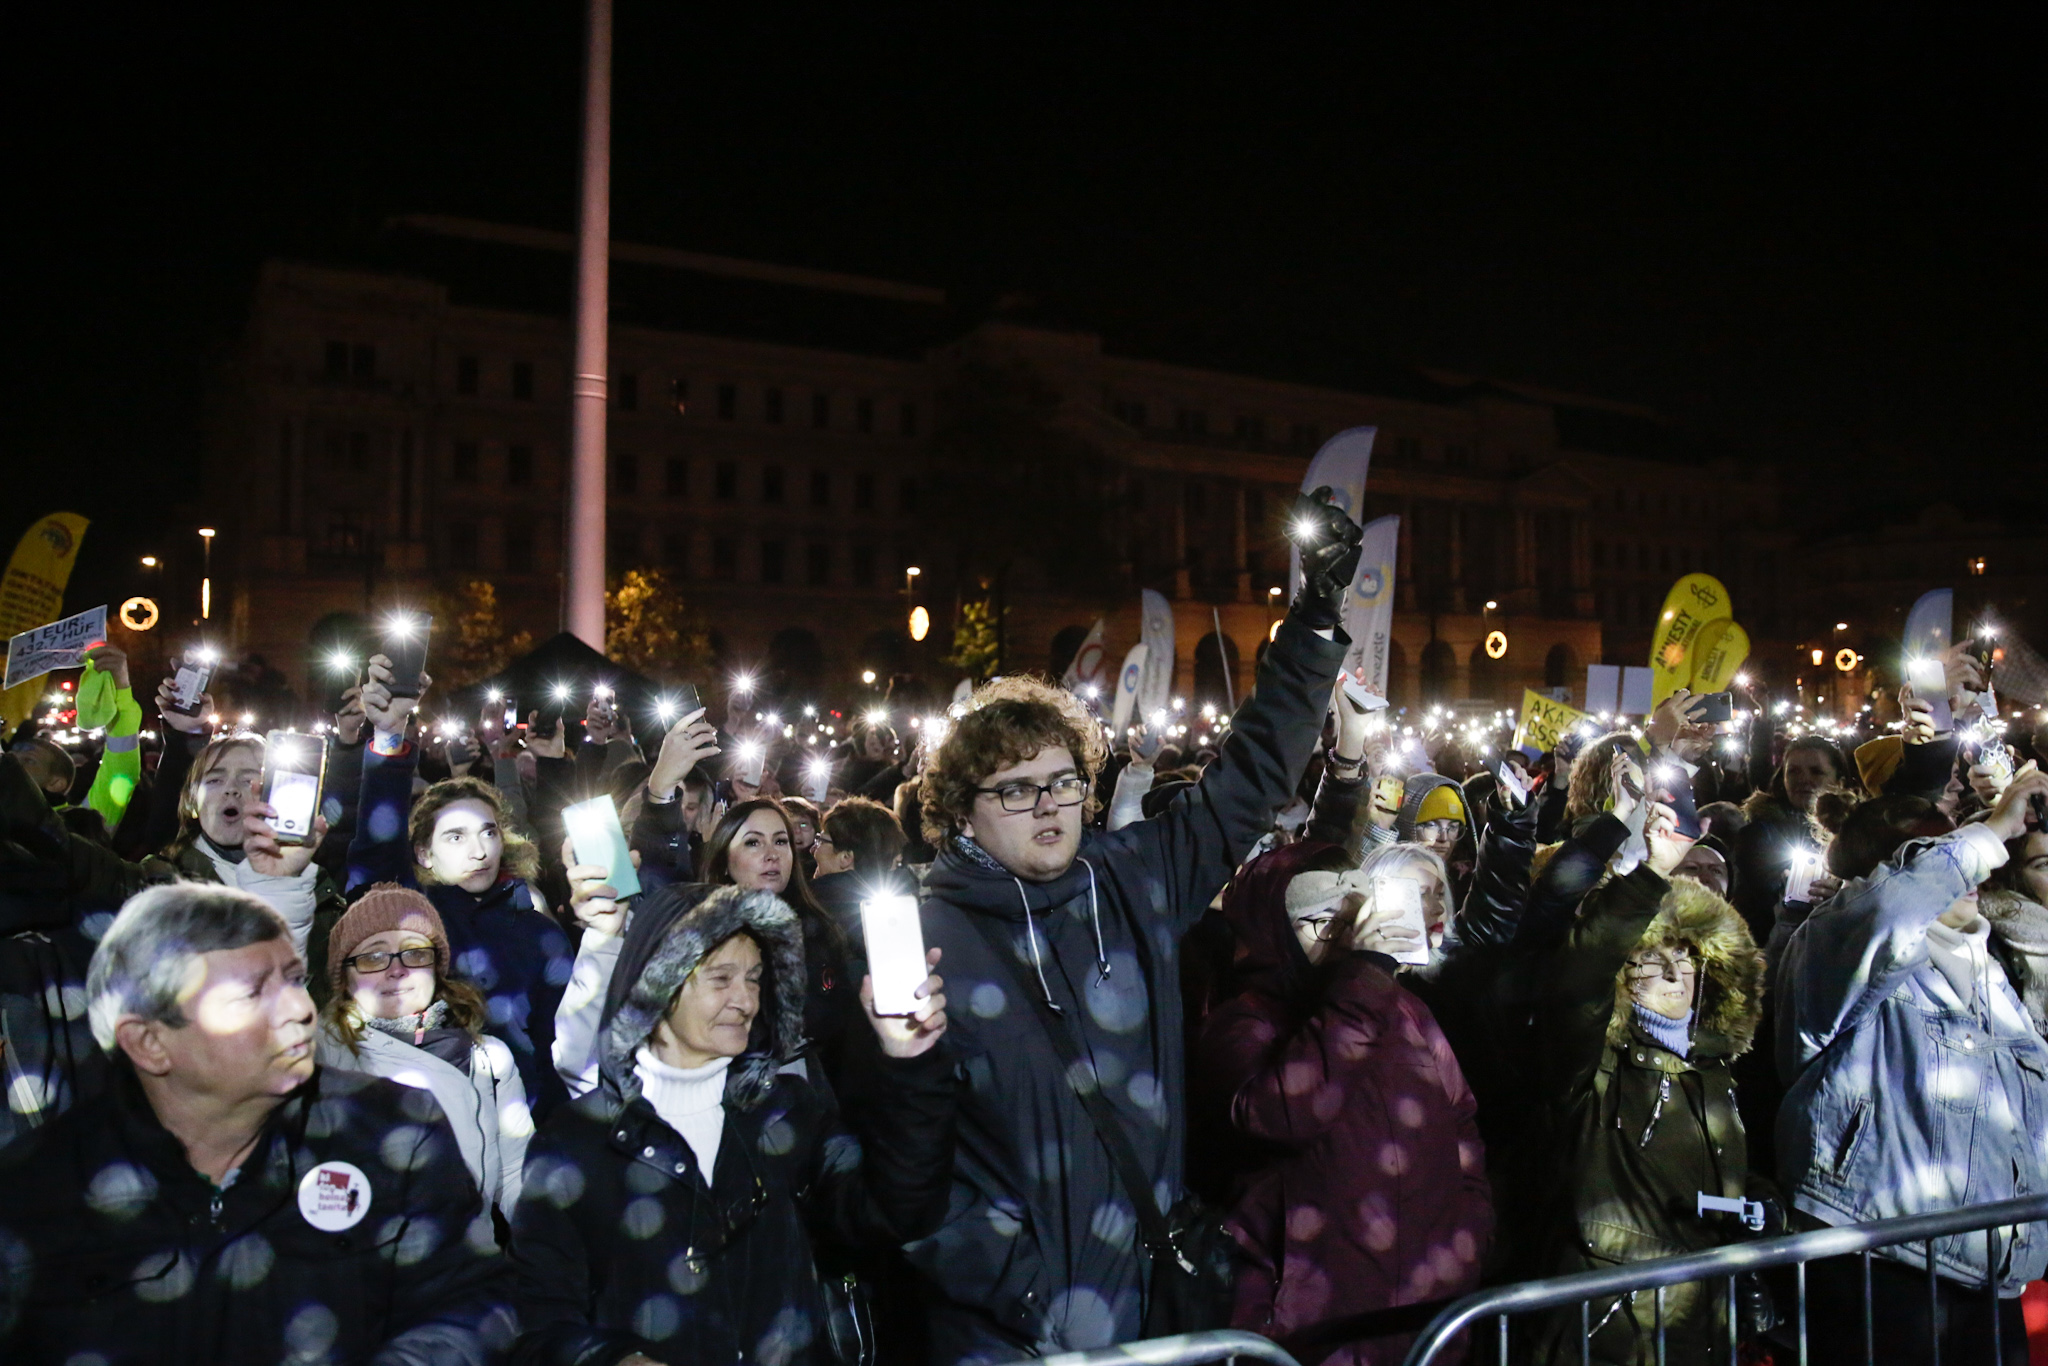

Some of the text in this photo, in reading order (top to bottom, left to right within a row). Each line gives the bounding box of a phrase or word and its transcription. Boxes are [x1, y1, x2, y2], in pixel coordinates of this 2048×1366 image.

[28, 632, 36, 644] 1
[62, 621, 95, 642] HUF
[1654, 608, 1693, 668] ANESTY
